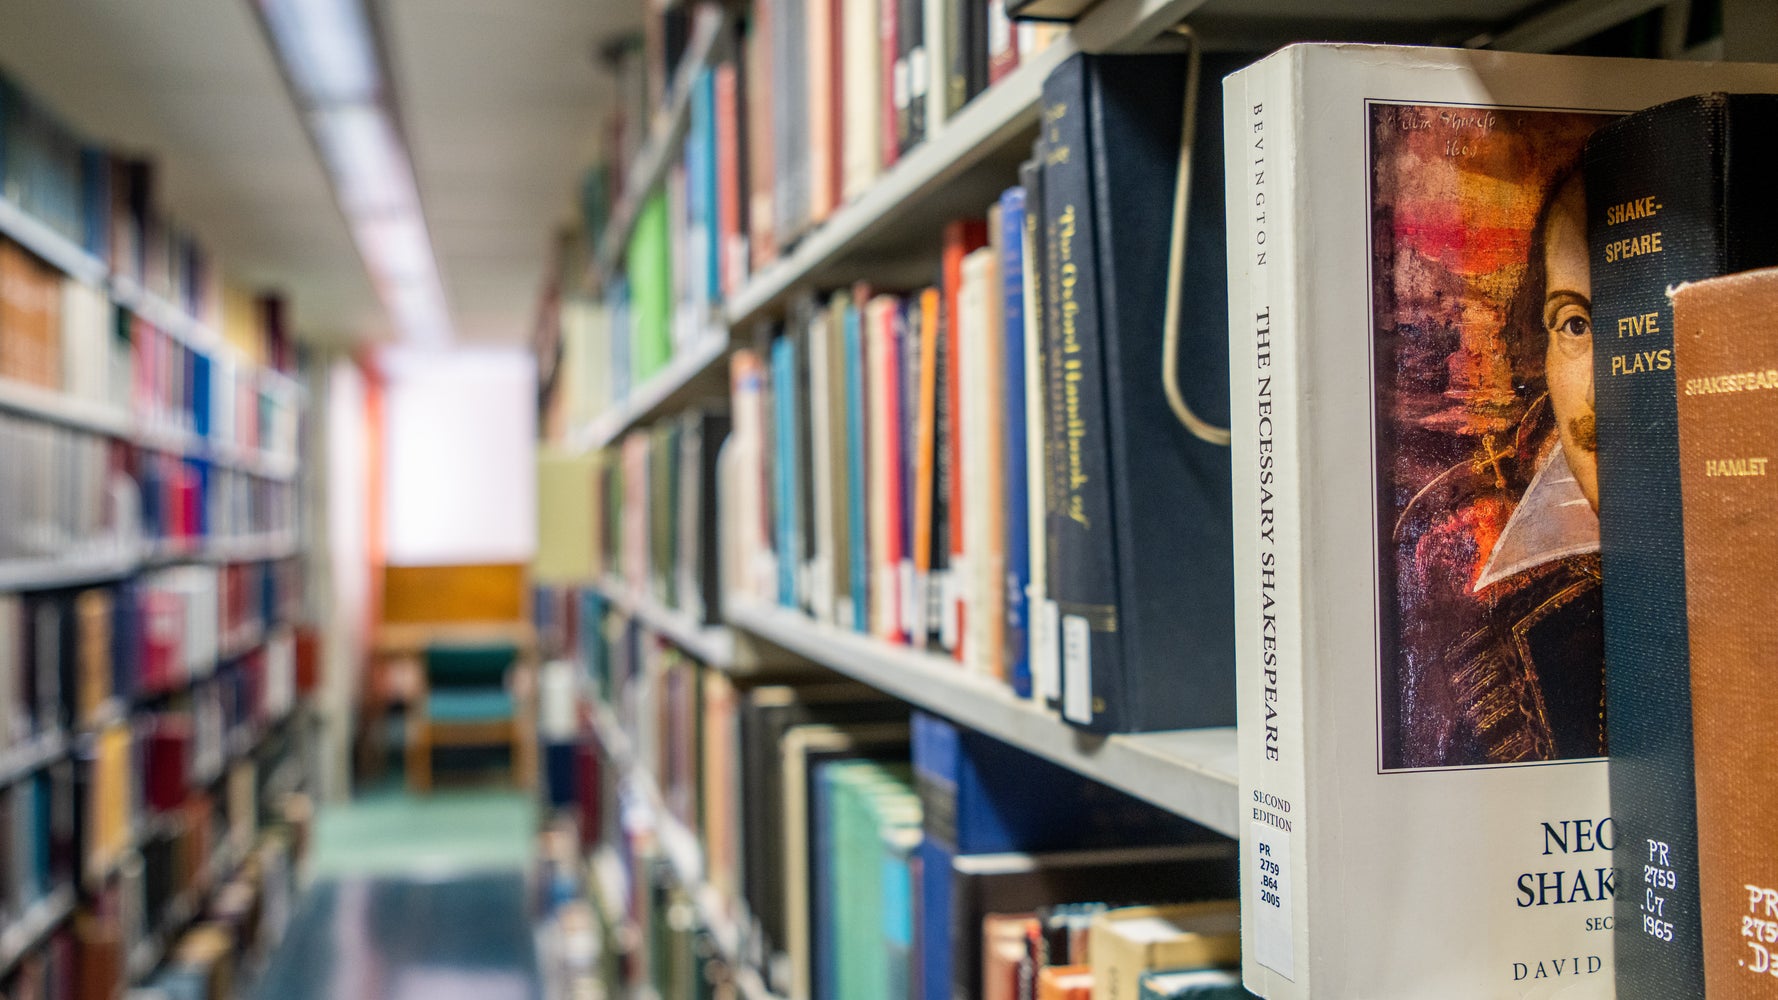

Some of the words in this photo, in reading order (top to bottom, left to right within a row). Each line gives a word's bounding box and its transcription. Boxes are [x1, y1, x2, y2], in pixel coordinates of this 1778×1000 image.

[1253, 103, 1266, 266] BEVINGTON
[1607, 195, 1663, 226] SHAKE-
[1605, 232, 1663, 264] SPEARE
[1256, 306, 1271, 369] THE
[1618, 311, 1660, 339] FIVE
[1612, 349, 1672, 377] PLAYS
[1258, 375, 1275, 545] NECESSARY
[1705, 457, 1768, 477] HAMLET
[1261, 552, 1279, 762] SHAKESPEARE
[1253, 789, 1291, 814] SECOND
[1253, 807, 1292, 833] EDITION
[1259, 842, 1271, 857] PR
[1647, 838, 1669, 867] PR
[1260, 858, 1280, 876] 2759
[1644, 864, 1676, 890] 2759
[1260, 875, 1278, 891] .B64
[1516, 867, 1615, 908] SHAK
[1261, 889, 1281, 908] 2005
[1640, 887, 1664, 917] .C7
[1744, 884, 1778, 920] PR
[1585, 916, 1614, 931] SEC
[1643, 913, 1674, 942] 1965
[1513, 956, 1602, 981] DAVID
